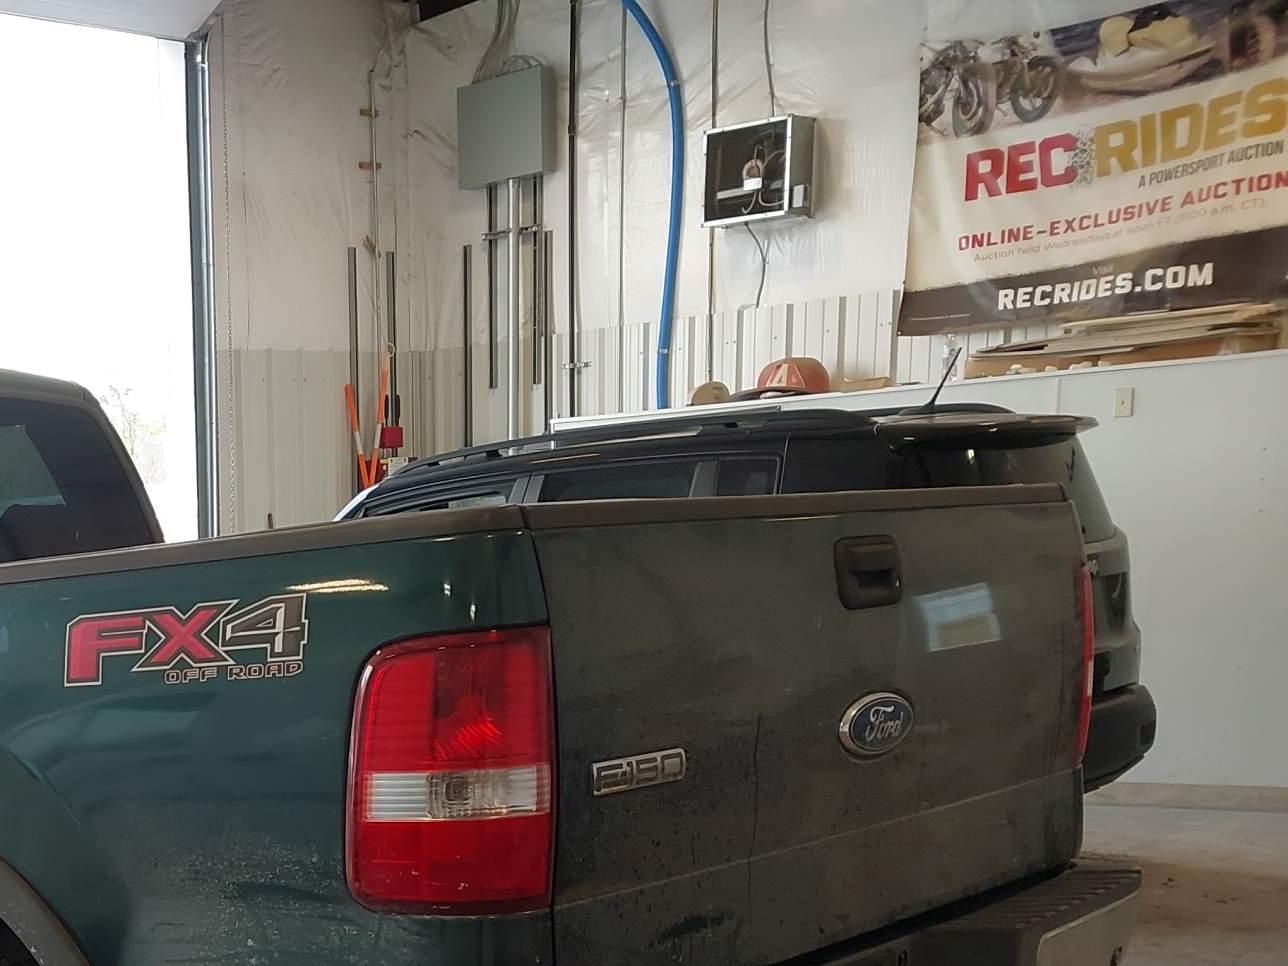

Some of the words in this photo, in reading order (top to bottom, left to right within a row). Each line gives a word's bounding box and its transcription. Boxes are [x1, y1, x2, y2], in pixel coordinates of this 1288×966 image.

[964, 132, 1079, 201] REC
[1094, 76, 1288, 179] RIDES
[1138, 174, 1147, 189] A
[1149, 152, 1225, 186] POWERSPORT
[1227, 139, 1285, 164] AUCTION
[958, 195, 1174, 251] ONLINE-EXCLUSIVE
[974, 248, 1015, 262] Auction
[997, 262, 1215, 312] RECRIDES.COM
[64, 593, 309, 688] FX4
[164, 667, 218, 685] OFF
[227, 660, 304, 681] ROAD
